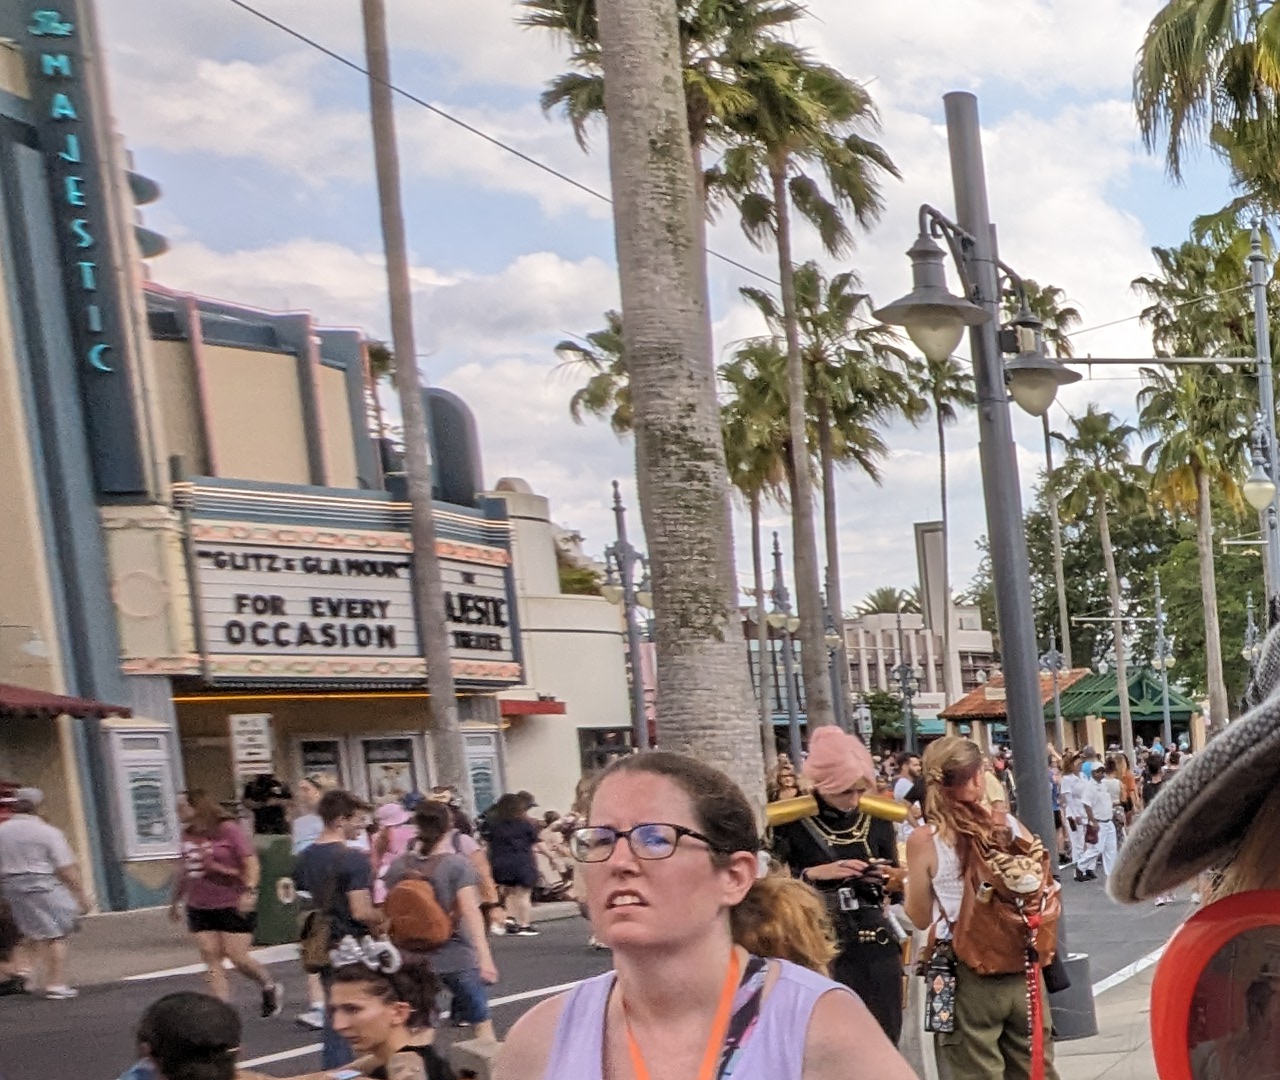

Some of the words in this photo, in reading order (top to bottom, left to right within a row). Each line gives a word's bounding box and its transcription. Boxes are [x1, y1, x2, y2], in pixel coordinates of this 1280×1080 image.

[41, 53, 114, 373] MAJESTIC
[235, 594, 287, 617] FOR
[311, 596, 391, 619] EVERY
[225, 619, 397, 649] OCCASION
